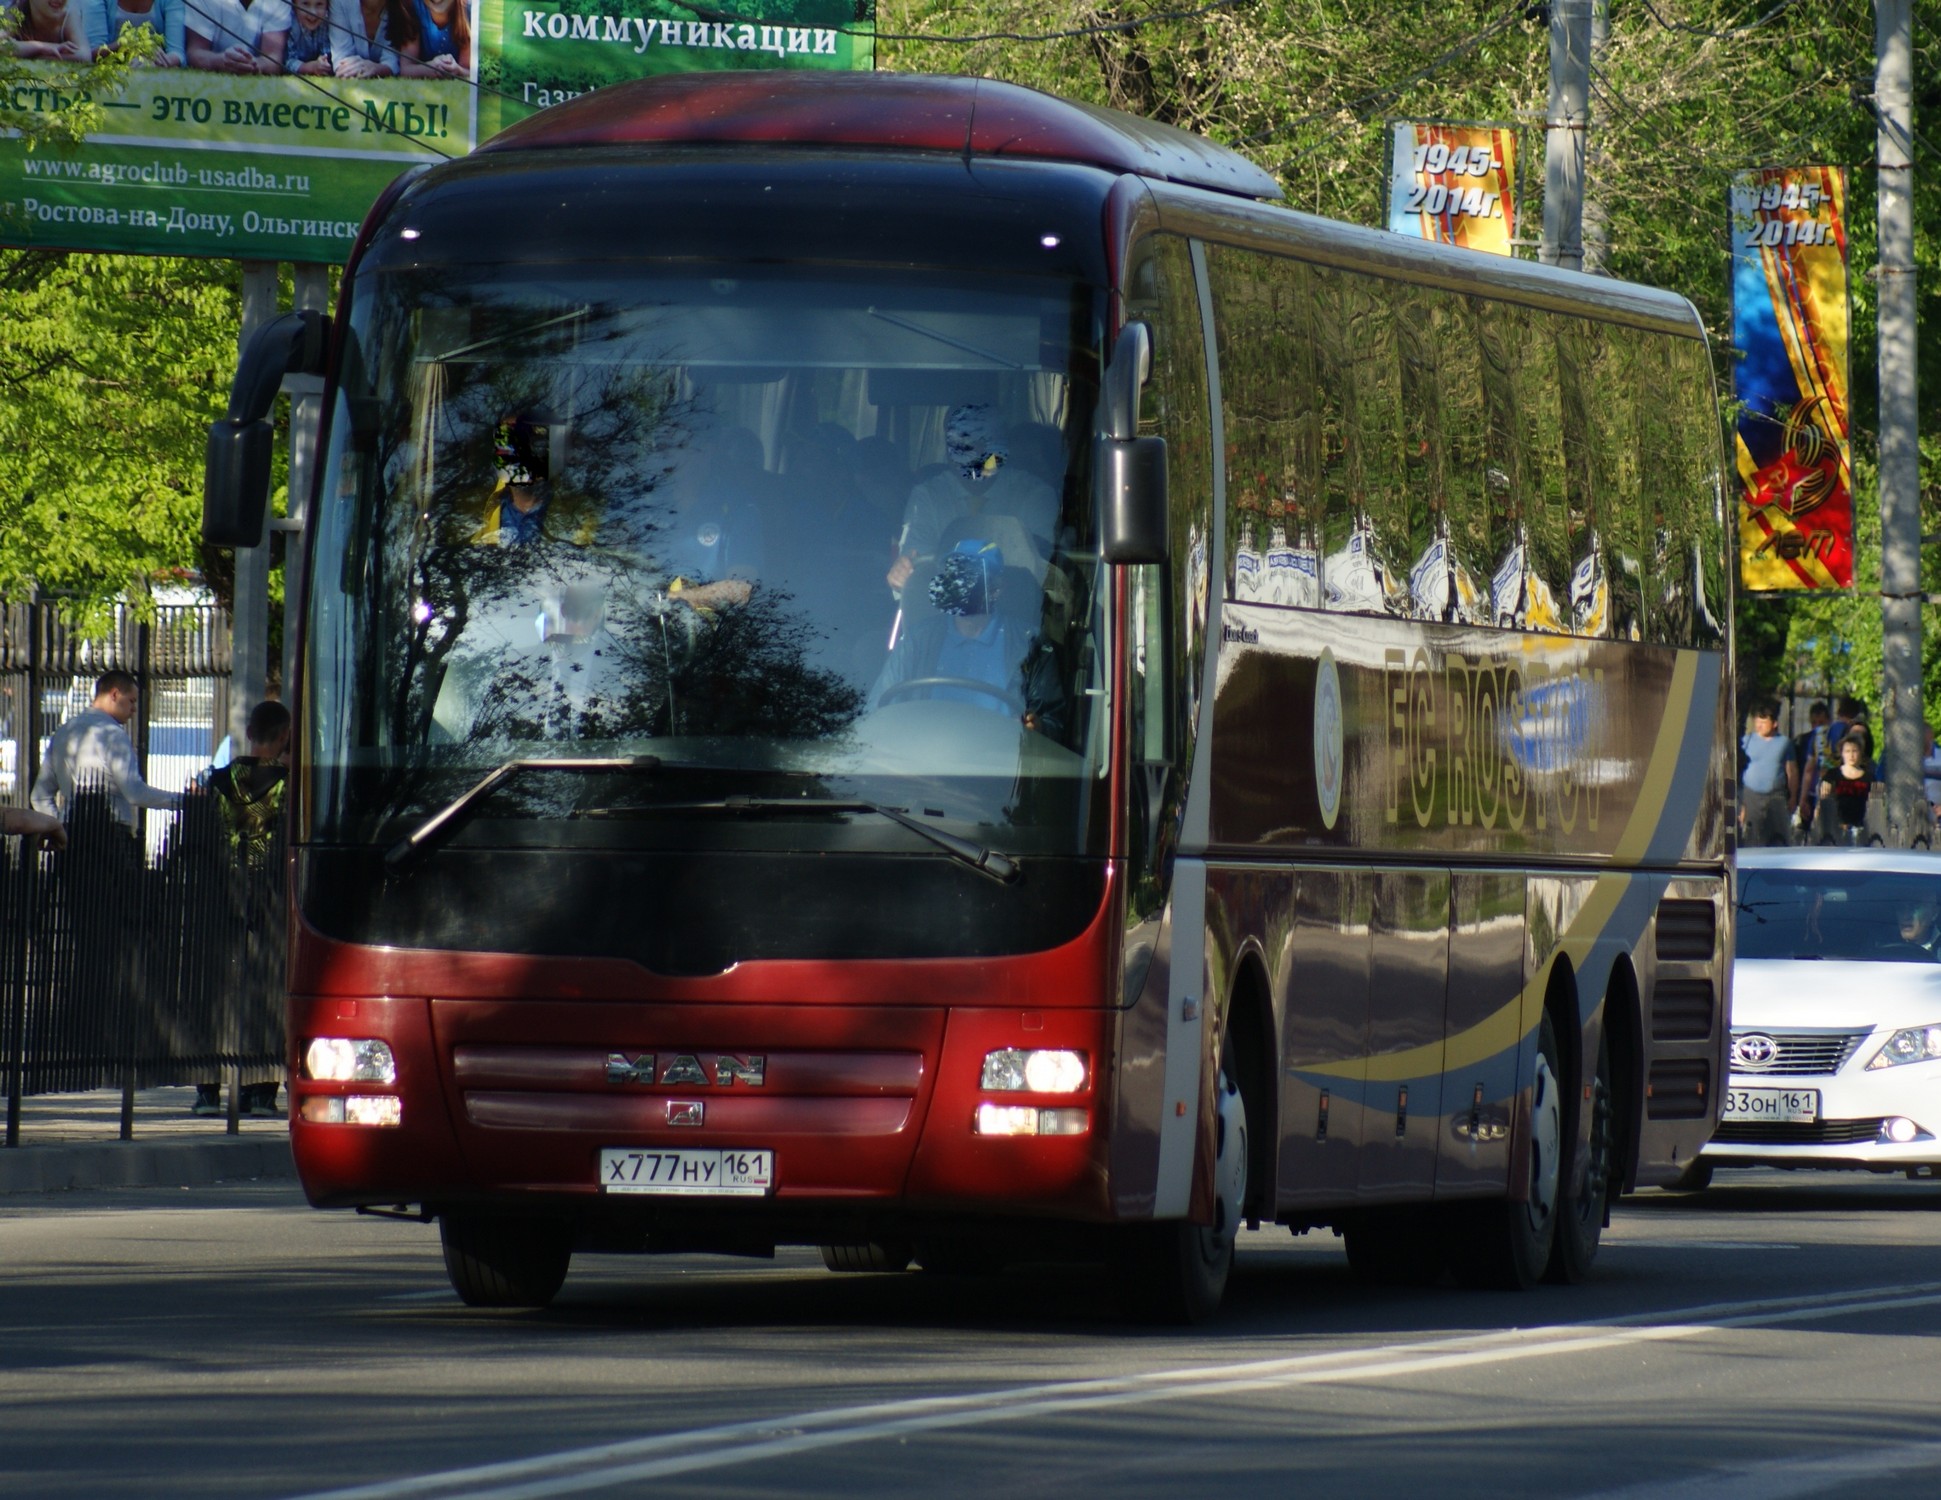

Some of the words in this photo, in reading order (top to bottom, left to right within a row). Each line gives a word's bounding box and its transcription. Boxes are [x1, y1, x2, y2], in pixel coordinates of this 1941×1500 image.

[523, 10, 838, 57] коммуникации
[152, 95, 212, 124] это
[222, 100, 350, 132] вместе
[361, 99, 448, 138] МЫ!
[22, 158, 310, 191] www.agroclub-usadba.ru
[1414, 143, 1502, 177] 1945-
[23, 198, 235, 237] Ростова-на-Дону,
[1404, 184, 1503, 218] 2014г.
[1745, 219, 1836, 248] 2014г.
[1385, 647, 1437, 828] FC
[1446, 654, 1604, 835] ROSTOV
[606, 1054, 765, 1086] MAN
[1782, 1093, 1810, 1108] 161
[724, 1153, 763, 1175] 161
